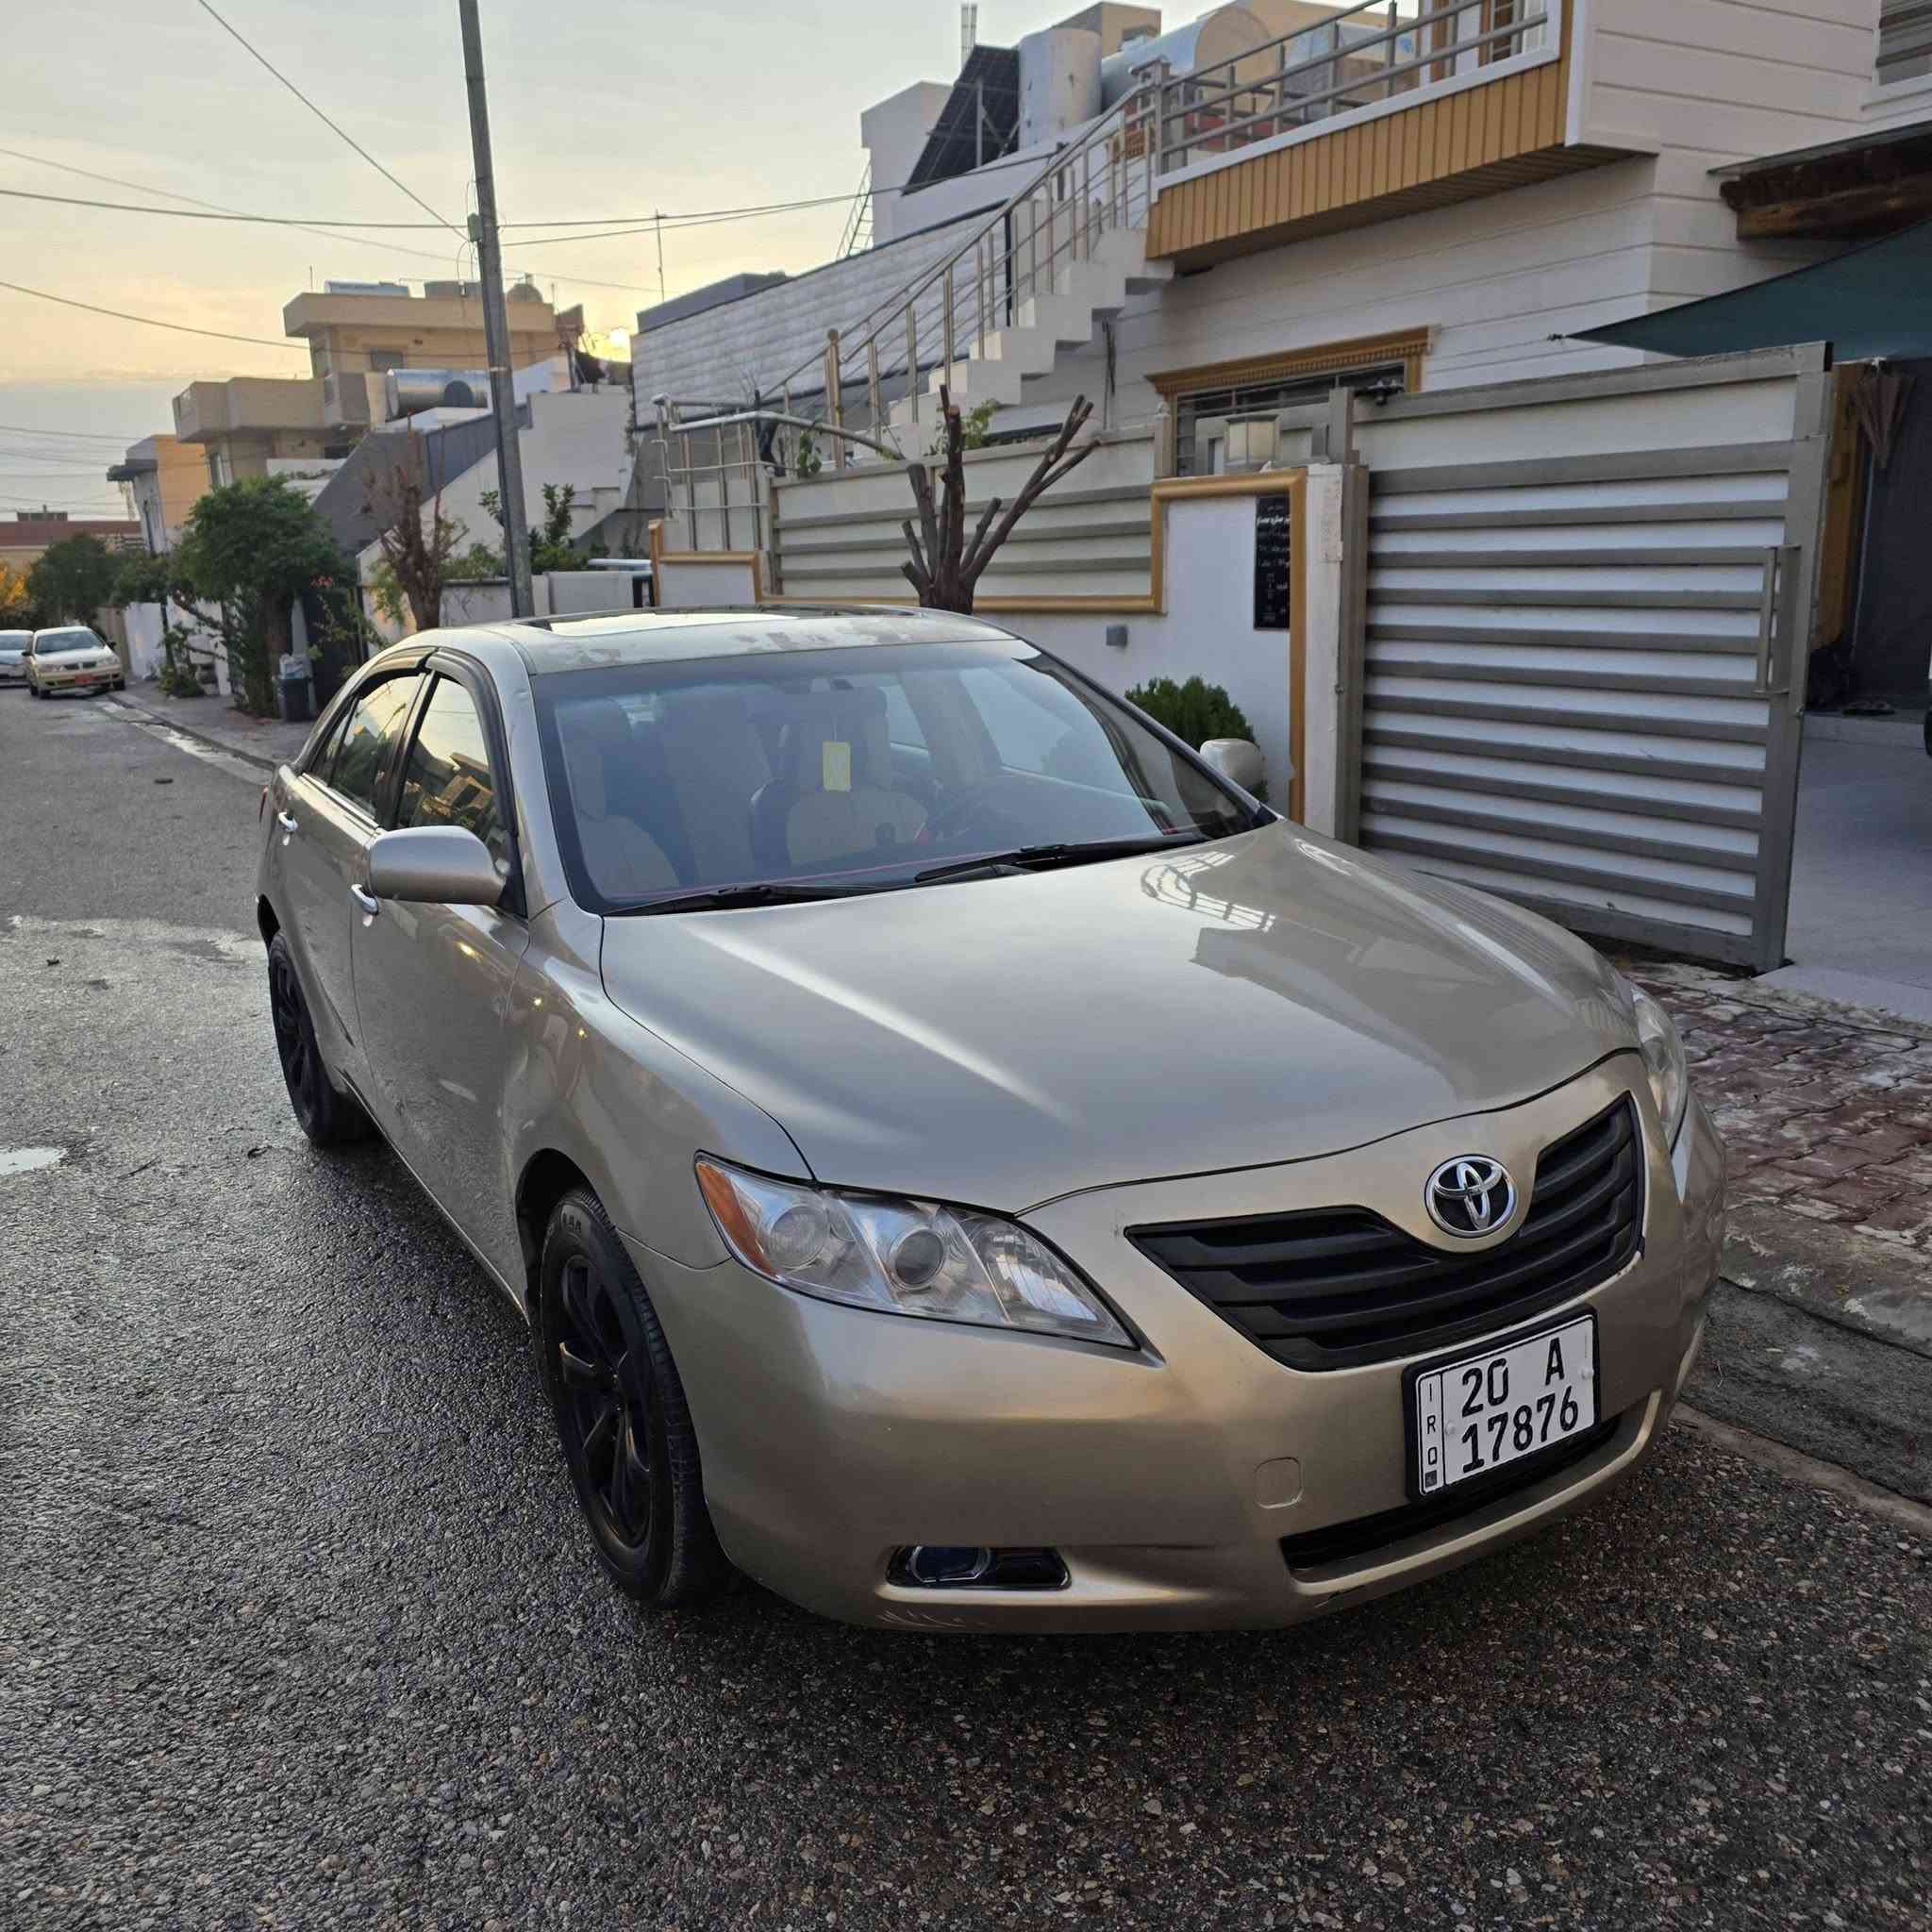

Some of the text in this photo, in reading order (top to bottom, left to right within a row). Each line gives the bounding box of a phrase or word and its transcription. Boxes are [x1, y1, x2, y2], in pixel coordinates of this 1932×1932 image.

[1462, 1337, 1564, 1417] 20 A
[1462, 1385, 1578, 1474] 17876
